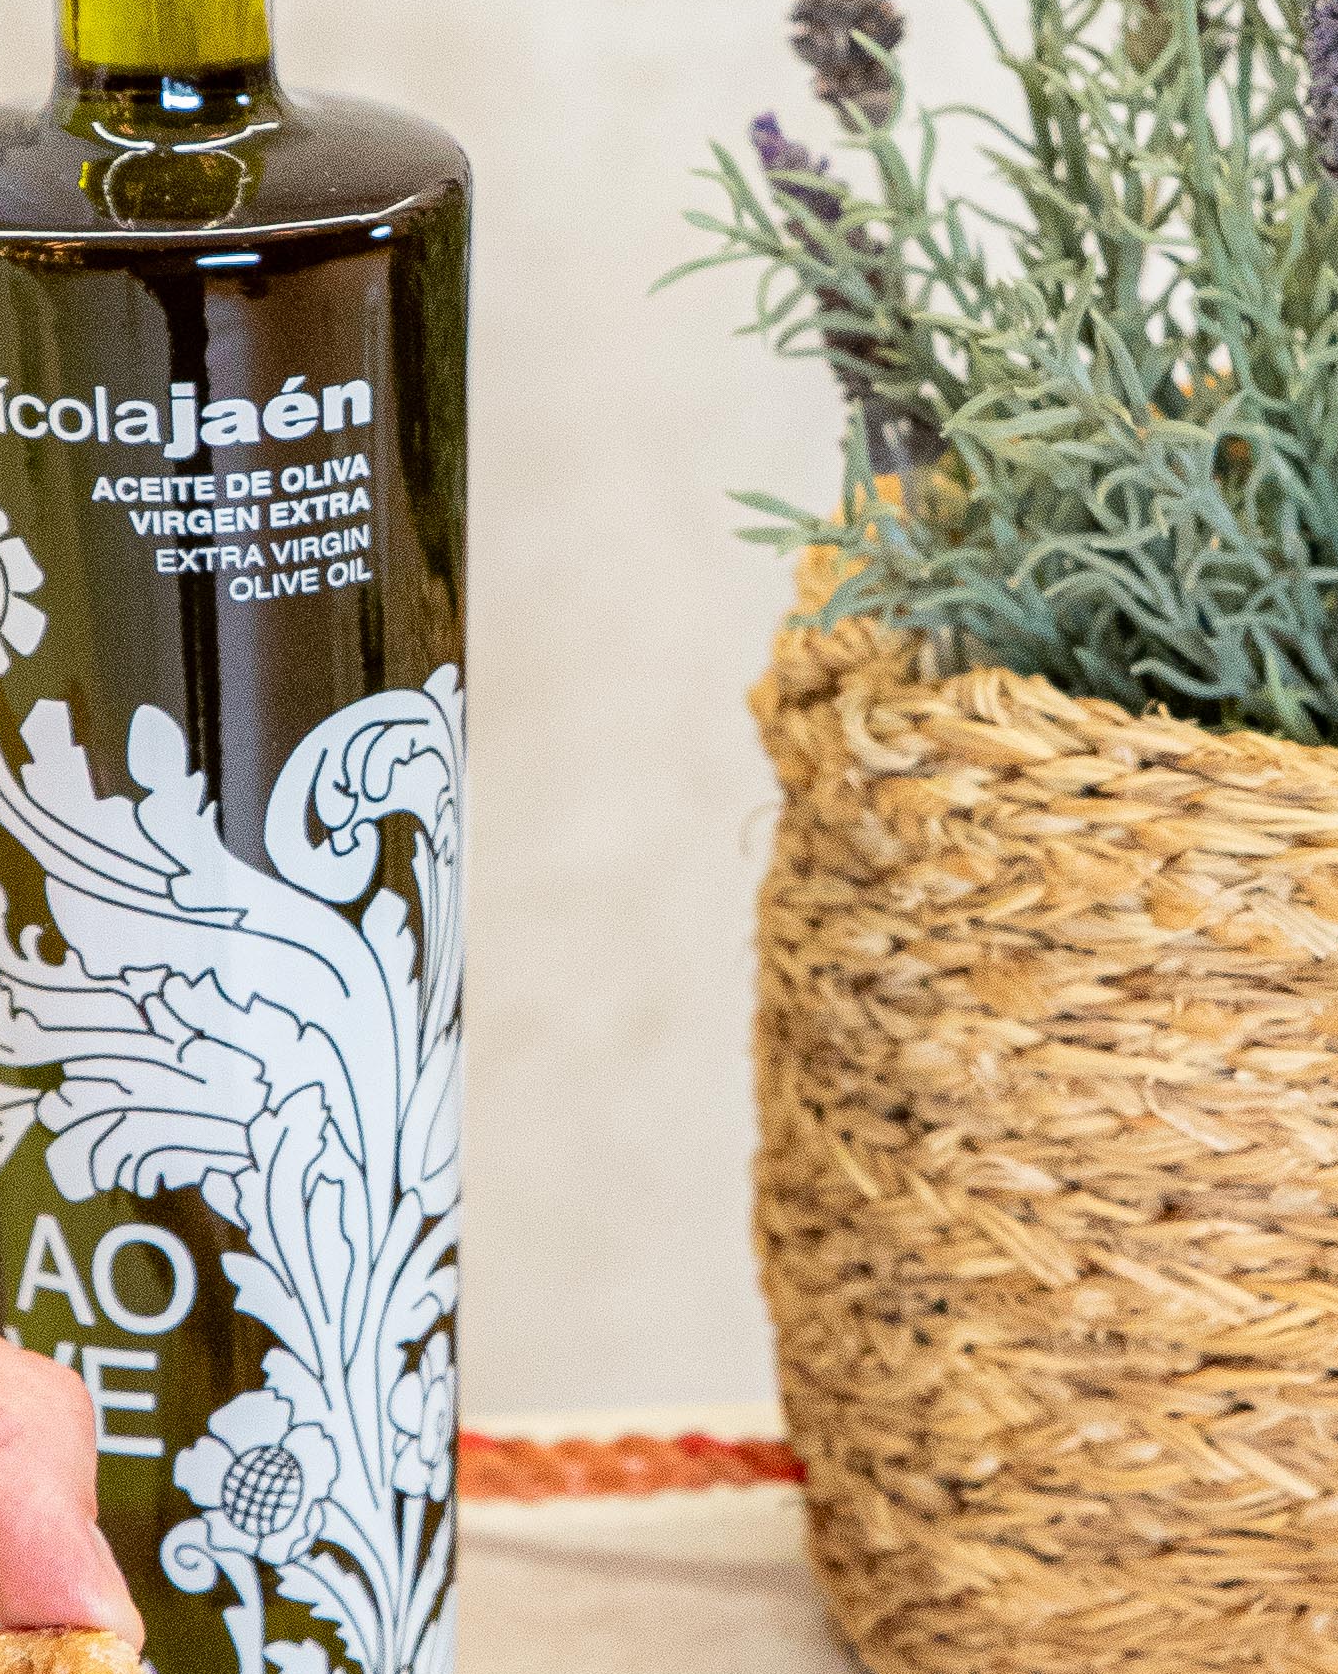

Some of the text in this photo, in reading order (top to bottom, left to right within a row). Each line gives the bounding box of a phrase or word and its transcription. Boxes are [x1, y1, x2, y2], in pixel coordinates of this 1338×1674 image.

[91, 453, 371, 503] ACEITE DE OLIVA
[128, 487, 372, 536] VIRGEN EXTRA
[155, 524, 371, 574] EXTRA VIRGIN
[228, 557, 373, 602] OLIVE OIL
[15, 1213, 198, 1336] AO
[4, 1326, 165, 1459] E
